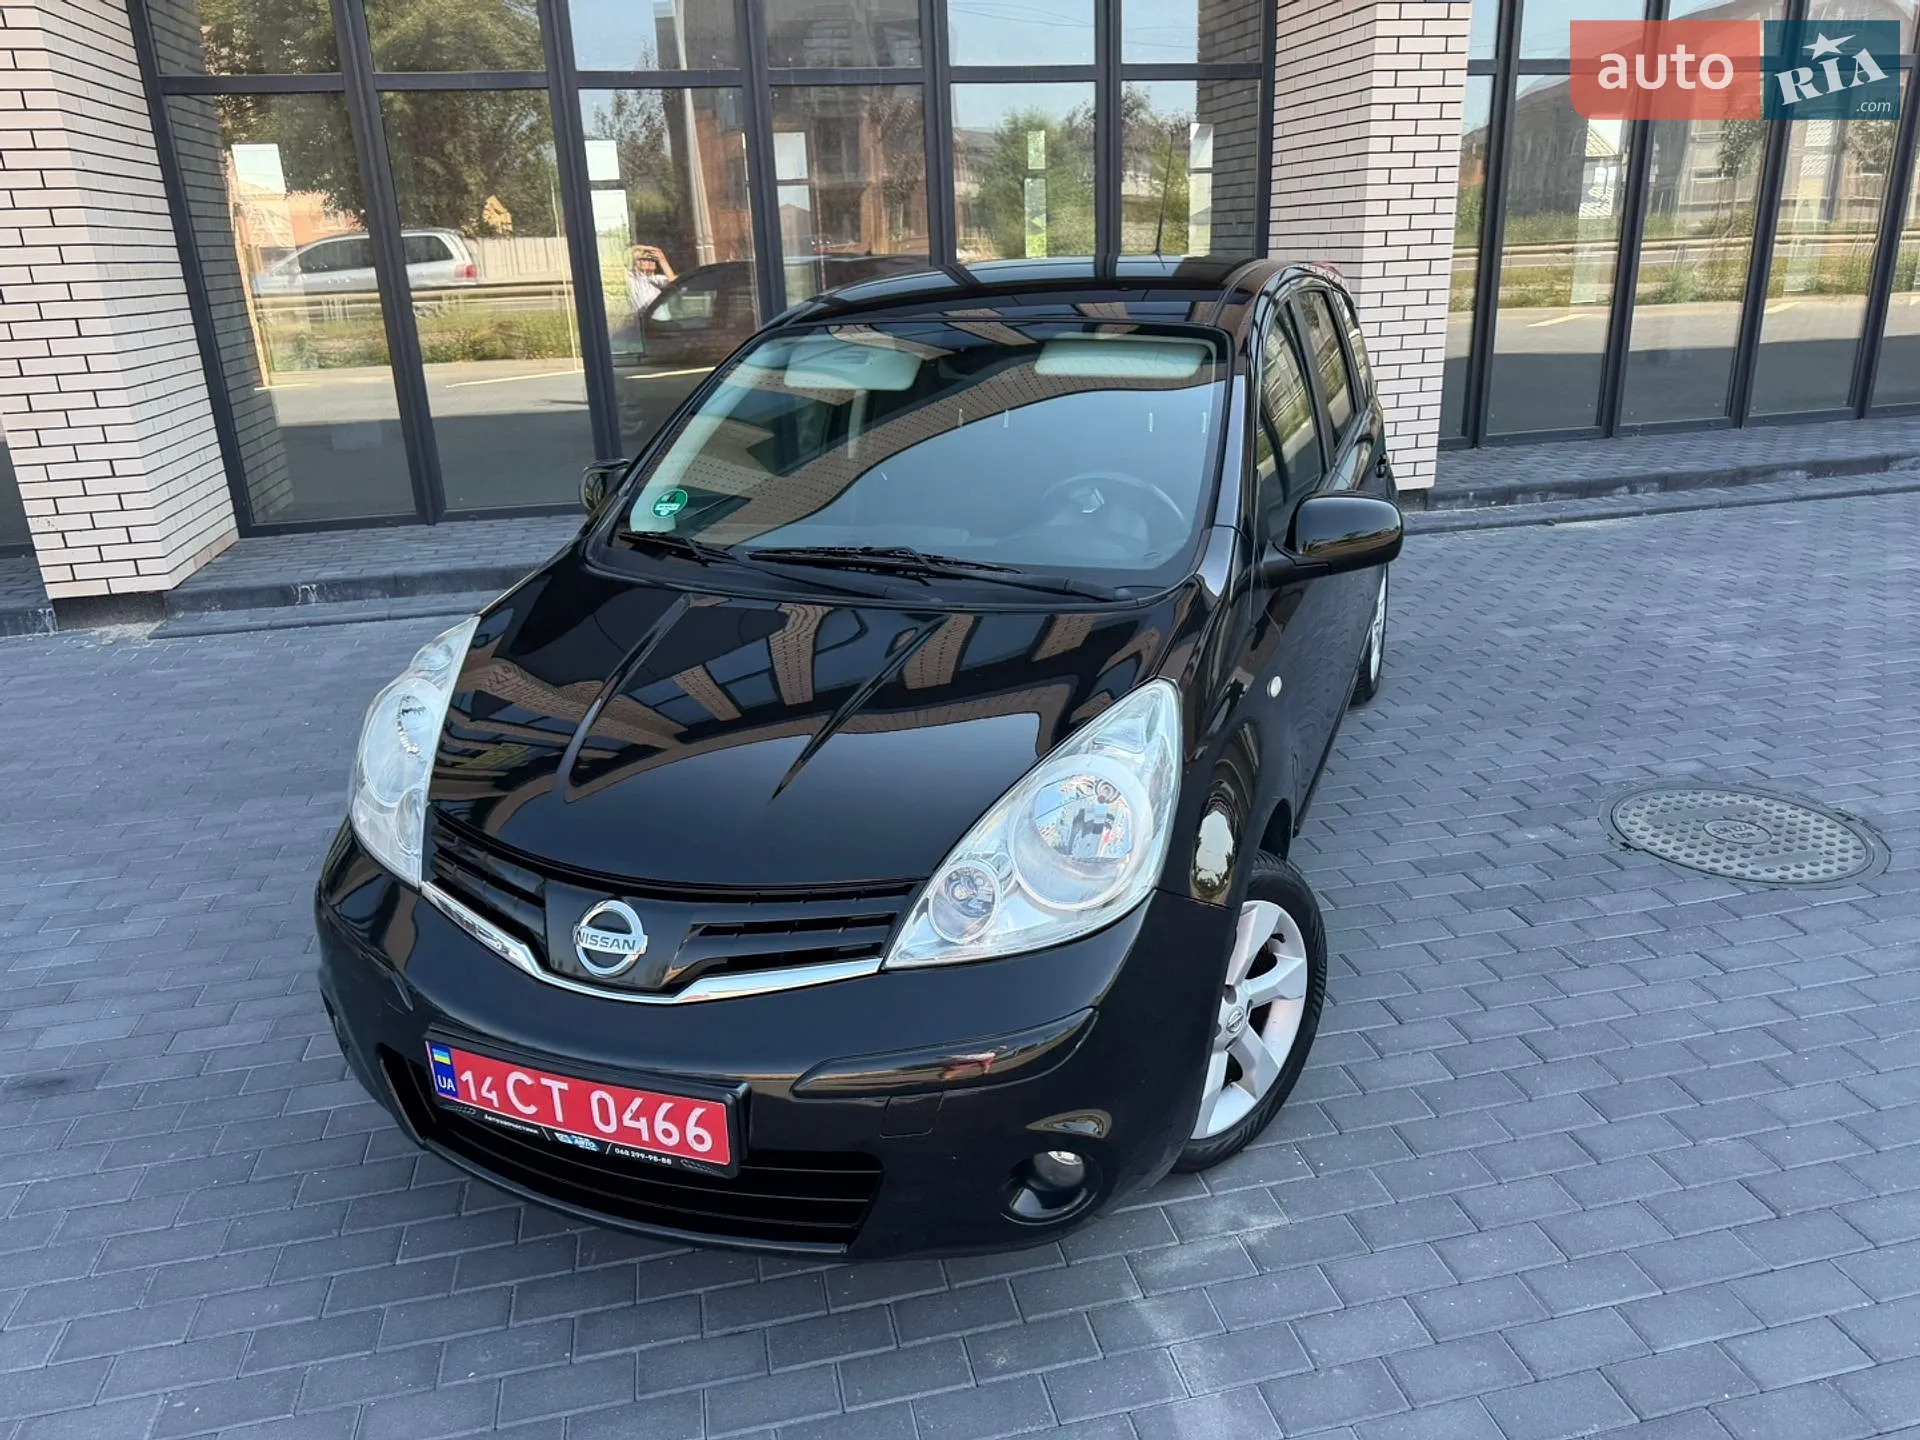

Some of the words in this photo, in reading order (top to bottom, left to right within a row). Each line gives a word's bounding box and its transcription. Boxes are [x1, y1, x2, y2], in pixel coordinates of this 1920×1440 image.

[577, 931, 636, 951] NISSAN
[437, 1074, 456, 1092] UA
[590, 1089, 713, 1153] 0466
